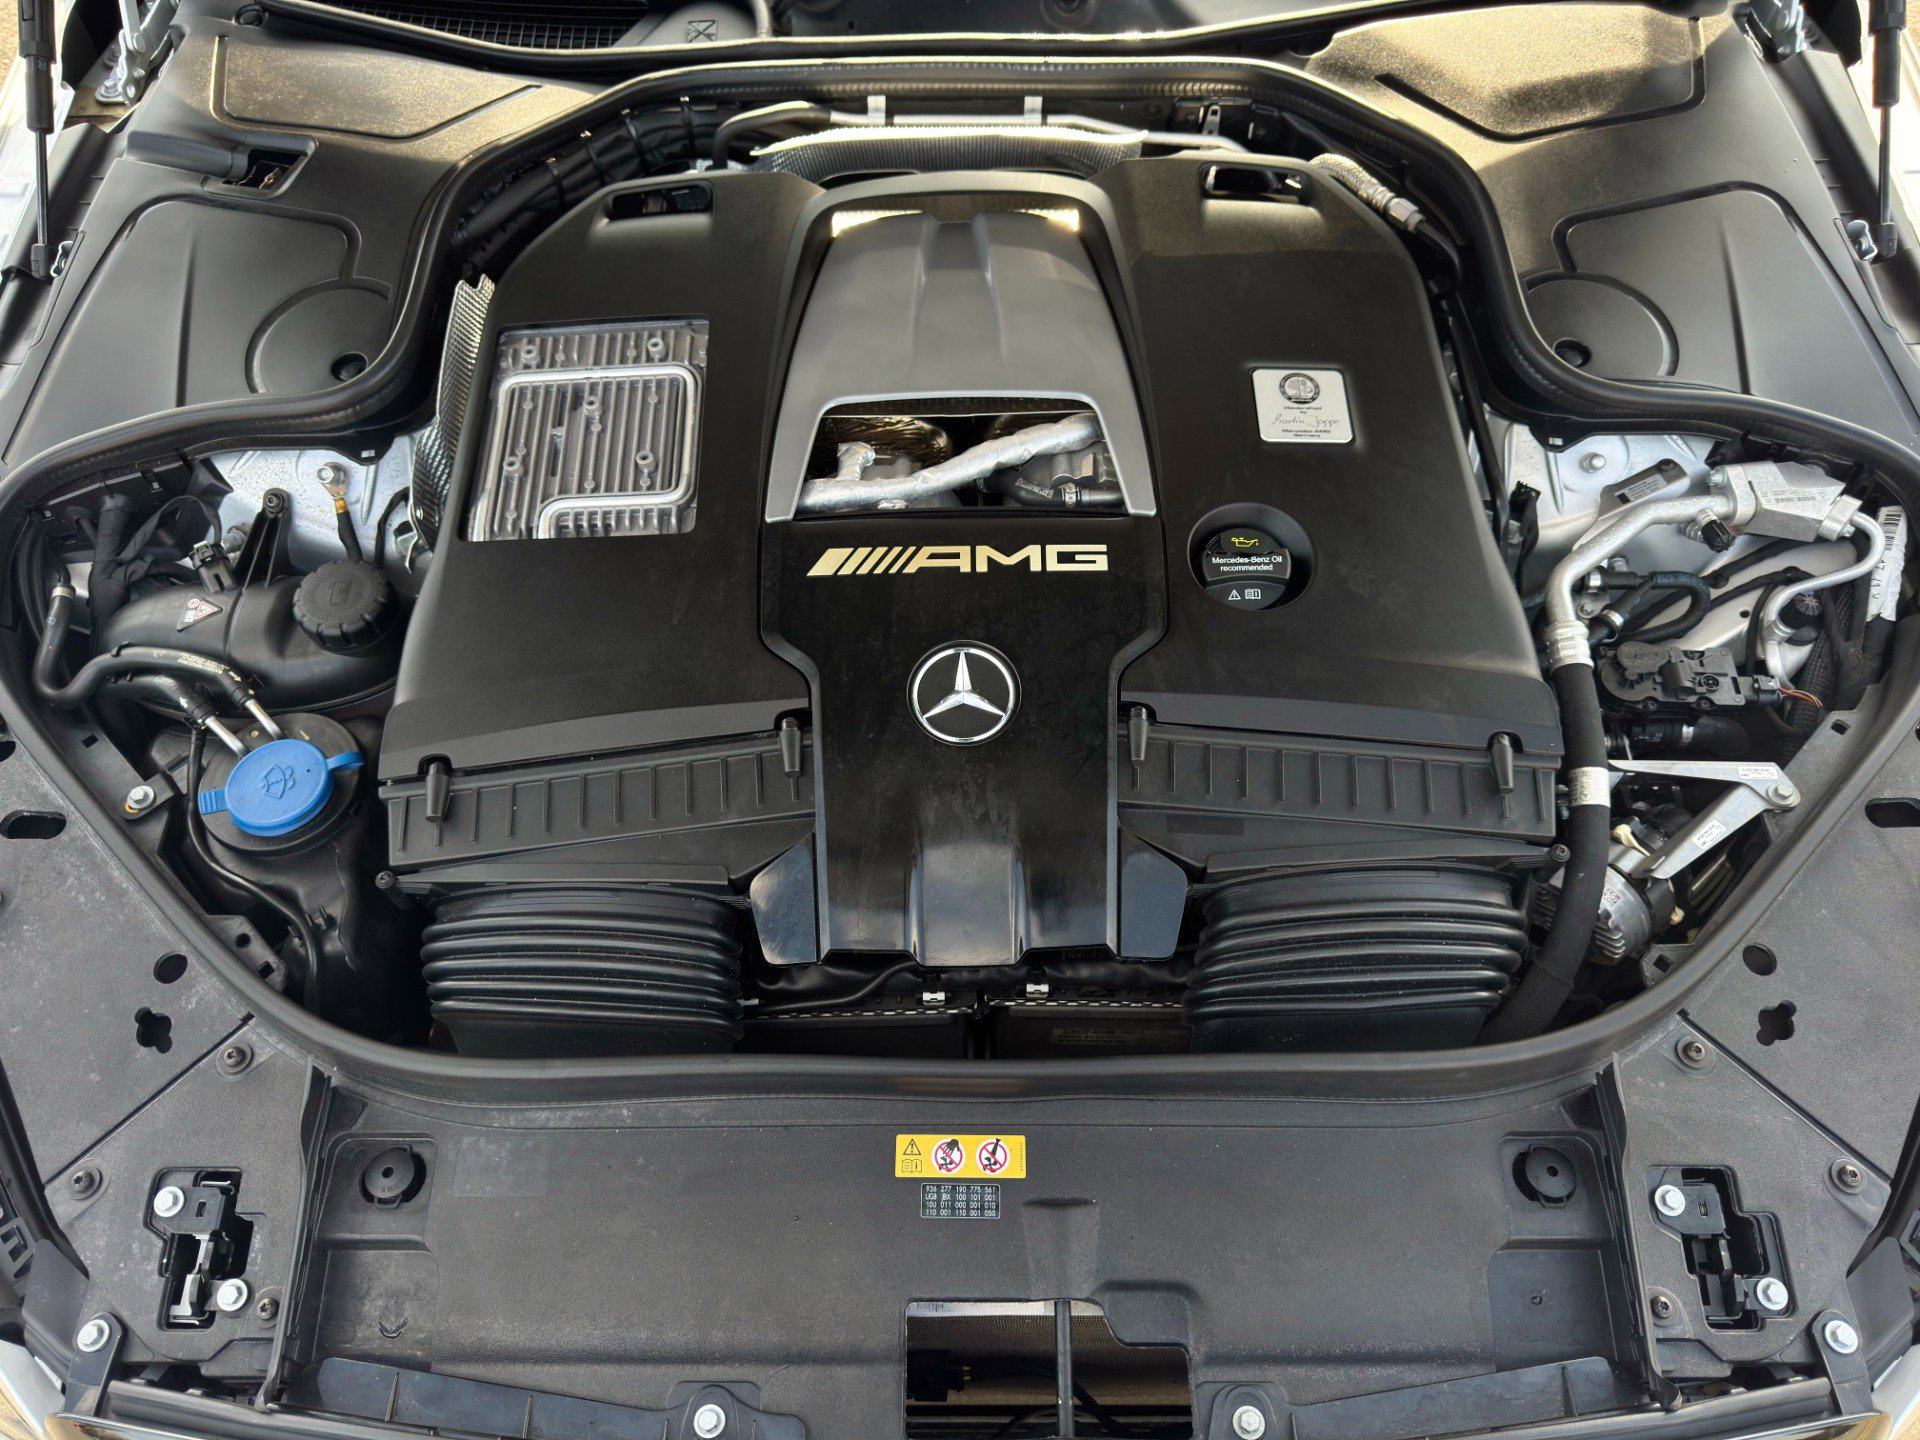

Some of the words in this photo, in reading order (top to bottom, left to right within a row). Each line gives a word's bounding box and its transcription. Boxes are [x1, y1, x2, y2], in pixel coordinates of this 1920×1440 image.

[902, 544, 1109, 574] AMG
[1211, 555, 1270, 565] Mercedes-Benz
[1271, 555, 1283, 563] Oil
[1220, 563, 1274, 572] recommended
